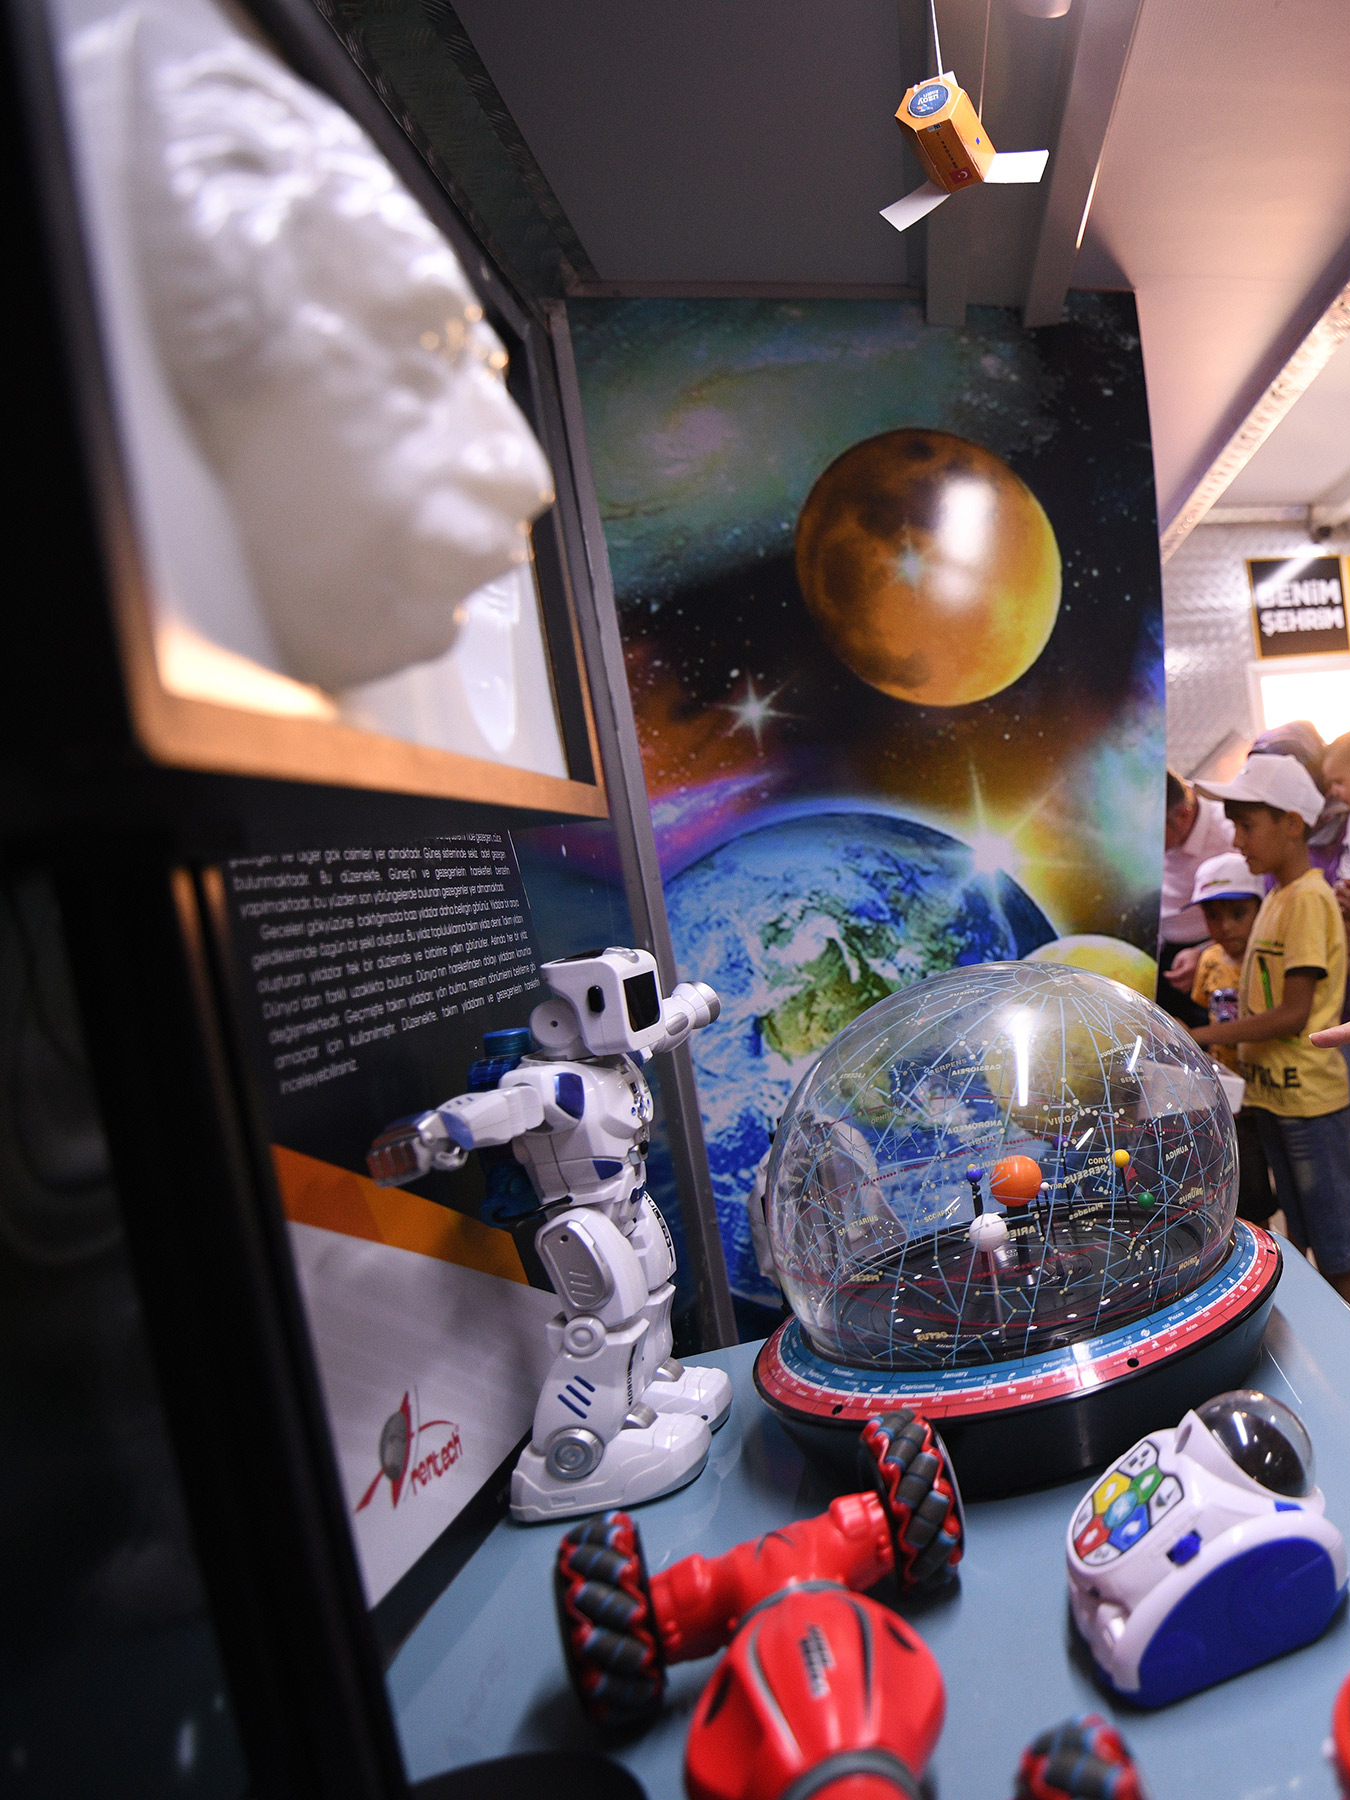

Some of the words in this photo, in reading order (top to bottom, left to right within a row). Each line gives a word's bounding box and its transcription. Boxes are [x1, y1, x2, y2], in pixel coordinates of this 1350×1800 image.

[421, 868, 430, 879] ve
[1047, 1113, 1079, 1126] VIRGO
[966, 1135, 996, 1148] LIBRA
[1088, 1157, 1111, 1165] CORV
[1048, 1183, 1067, 1191] YDRA
[942, 1370, 968, 1379] January
[900, 1383, 936, 1391] Capricornus
[1020, 1393, 1034, 1401] May
